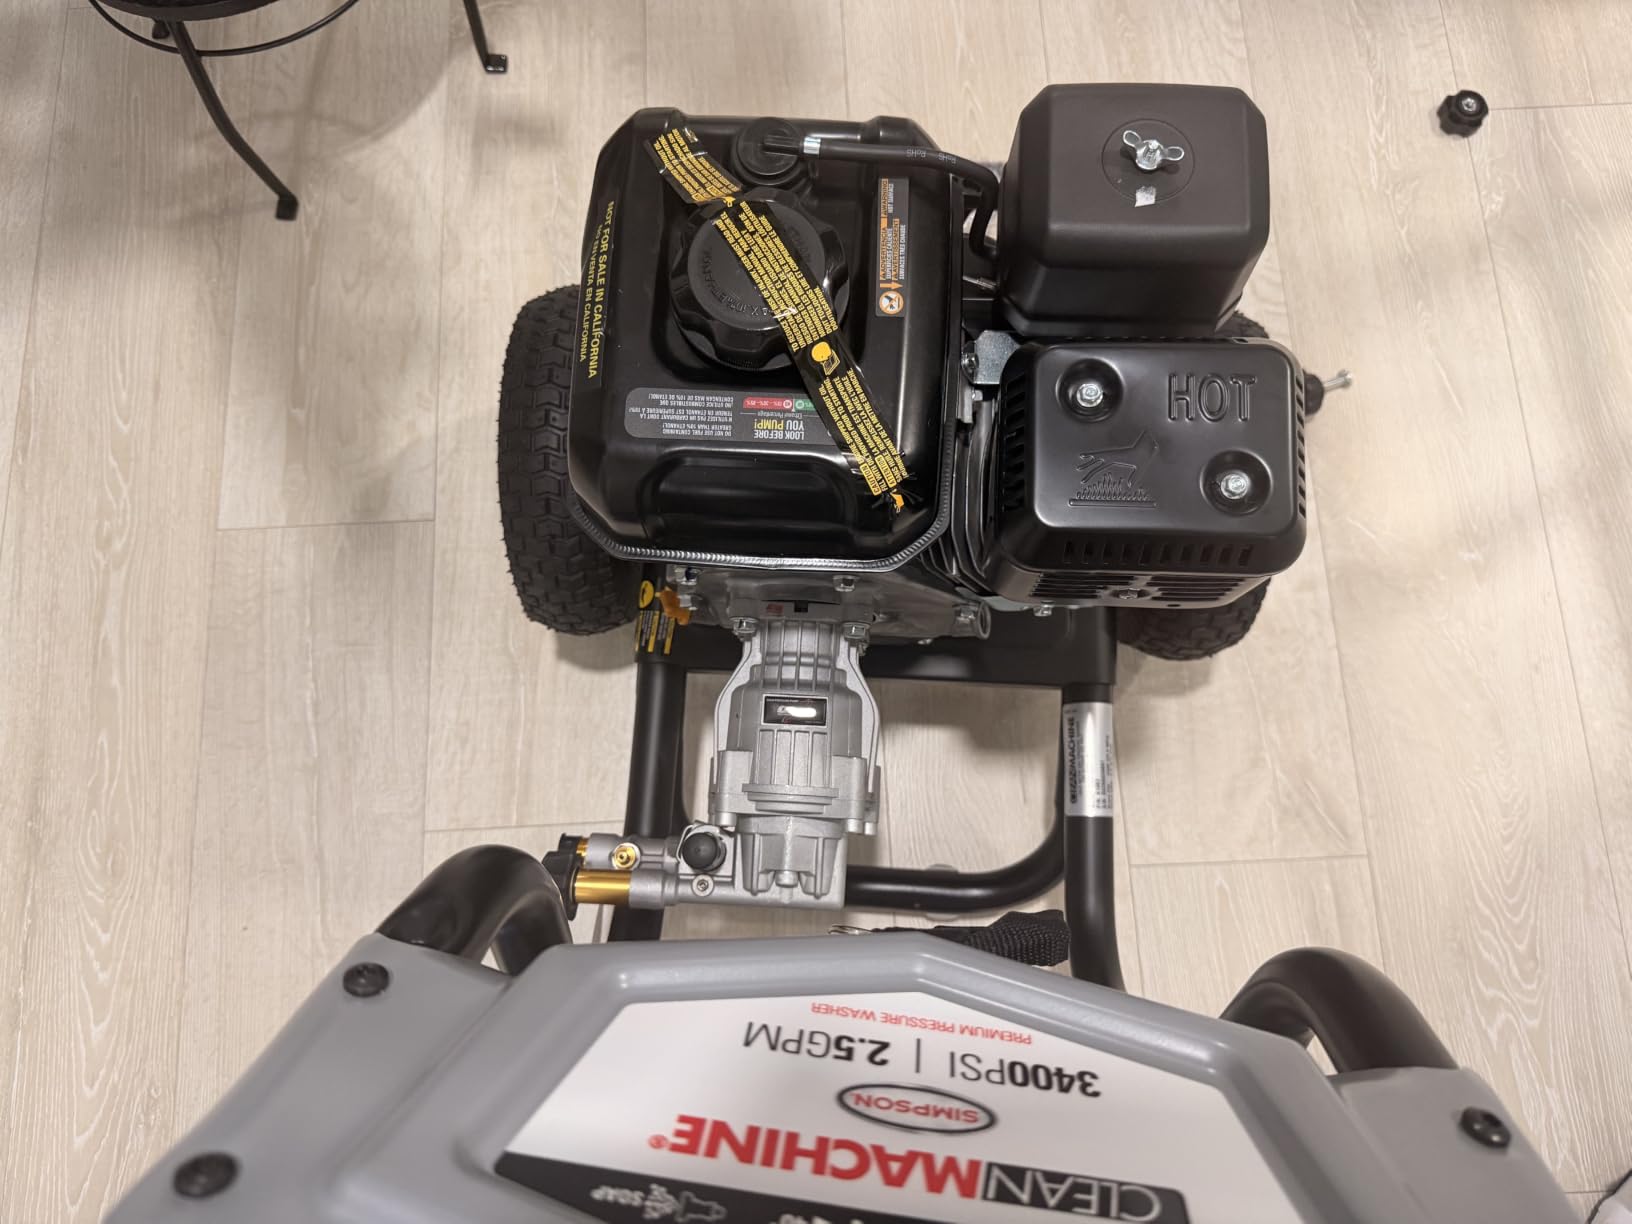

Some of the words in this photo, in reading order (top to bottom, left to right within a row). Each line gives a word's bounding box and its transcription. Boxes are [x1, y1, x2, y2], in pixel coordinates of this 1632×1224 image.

[604, 200, 613, 224] NOT
[719, 211, 728, 219] EL
[738, 211, 747, 221] DE
[599, 227, 609, 253] FOR
[768, 229, 776, 238] LE
[591, 240, 598, 255] EN
[731, 242, 744, 257] MUST
[736, 237, 750, 251] PARA
[586, 254, 596, 286] VENTA
[595, 254, 606, 286] SALE
[740, 255, 753, 270] USER
[781, 263, 791, 273] DE
[777, 270, 786, 280] DE
[794, 269, 803, 278] ET
[774, 280, 782, 288] EL
[786, 271, 804, 296] RISQUES
[798, 276, 810, 290] LIRE
[585, 288, 592, 301] EN
[594, 287, 603, 302] IN
[761, 273, 787, 311] INSTRUCTION
[761, 288, 770, 298] OF
[782, 279, 801, 304] MANUAL
[765, 296, 778, 310] RISK
[796, 302, 804, 311] EL
[799, 294, 810, 306] LES
[806, 288, 825, 319] TOUJOURS
[772, 308, 784, 321] TE
[793, 313, 802, 323] DE
[579, 303, 591, 362] CALIFORNIA
[779, 319, 796, 343] REDUCE
[800, 309, 819, 341] ENTENDER
[821, 319, 832, 334] DOIT
[797, 322, 813, 345] RIESGO
[588, 304, 602, 379] CALIFORNIA
[790, 341, 800, 352] TO
[851, 396, 863, 411] AVEC
[858, 392, 867, 402] EN
[1167, 373, 1257, 422] HOT
[822, 393, 841, 421] WITHOUT
[836, 404, 845, 414] TO
[858, 410, 867, 419] LA
[862, 401, 878, 424] METTRE
[753, 418, 783, 429] PUMP!
[786, 419, 804, 430] YOU
[841, 412, 854, 431] PRIOR
[851, 411, 861, 423] EST
[753, 429, 783, 439] BEFORE
[836, 419, 853, 444] SHIPPED
[863, 417, 886, 450] REMPLISSEZ
[874, 422, 883, 431] LA
[878, 429, 887, 438] DE
[784, 430, 804, 439] LOOK
[857, 421, 875, 448] MACHINE
[850, 429, 869, 457] PROVIDED
[871, 446, 879, 455] LA
[864, 455, 874, 466] OIL
[861, 464, 880, 493] CAUTION
[869, 464, 882, 481] WITH
[890, 466, 903, 482] SANS
[877, 479, 888, 491] FILL
[811, 1002, 876, 1022] WASHER
[881, 1013, 955, 1033] PRESSURE
[959, 1024, 1032, 1045] PREMIUM
[743, 1021, 890, 1066] 2.5GPM
[949, 1051, 1101, 1098] 3400PSI
[852, 1093, 979, 1123] SIMPSON
